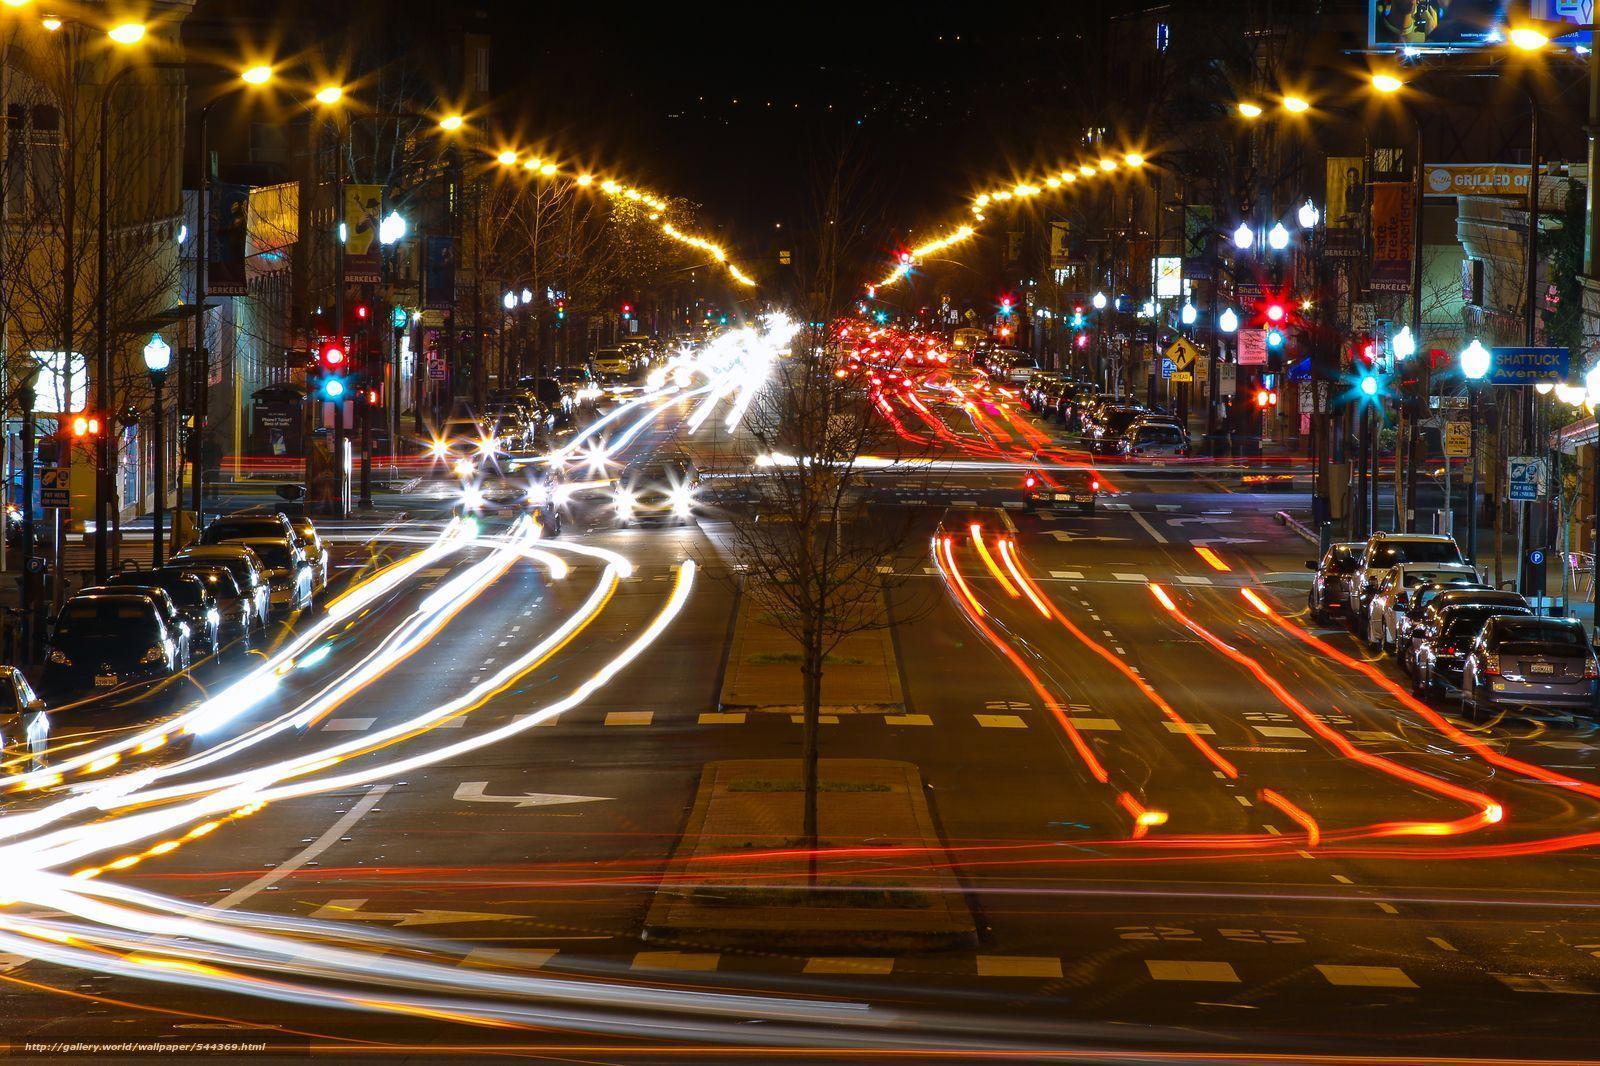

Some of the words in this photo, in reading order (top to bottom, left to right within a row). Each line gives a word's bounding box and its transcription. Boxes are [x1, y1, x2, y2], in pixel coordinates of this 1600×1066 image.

[1454, 175, 1511, 186] GRILLED
[1324, 249, 1361, 257] BERKELEY
[344, 275, 382, 283] BERKELEY
[207, 286, 248, 294] BERKELEY
[1238, 286, 1266, 295] Shattu
[1370, 283, 1412, 291] BERKELEY
[1495, 354, 1560, 366] SHATTUCK
[1494, 368, 1559, 378] Avenue
